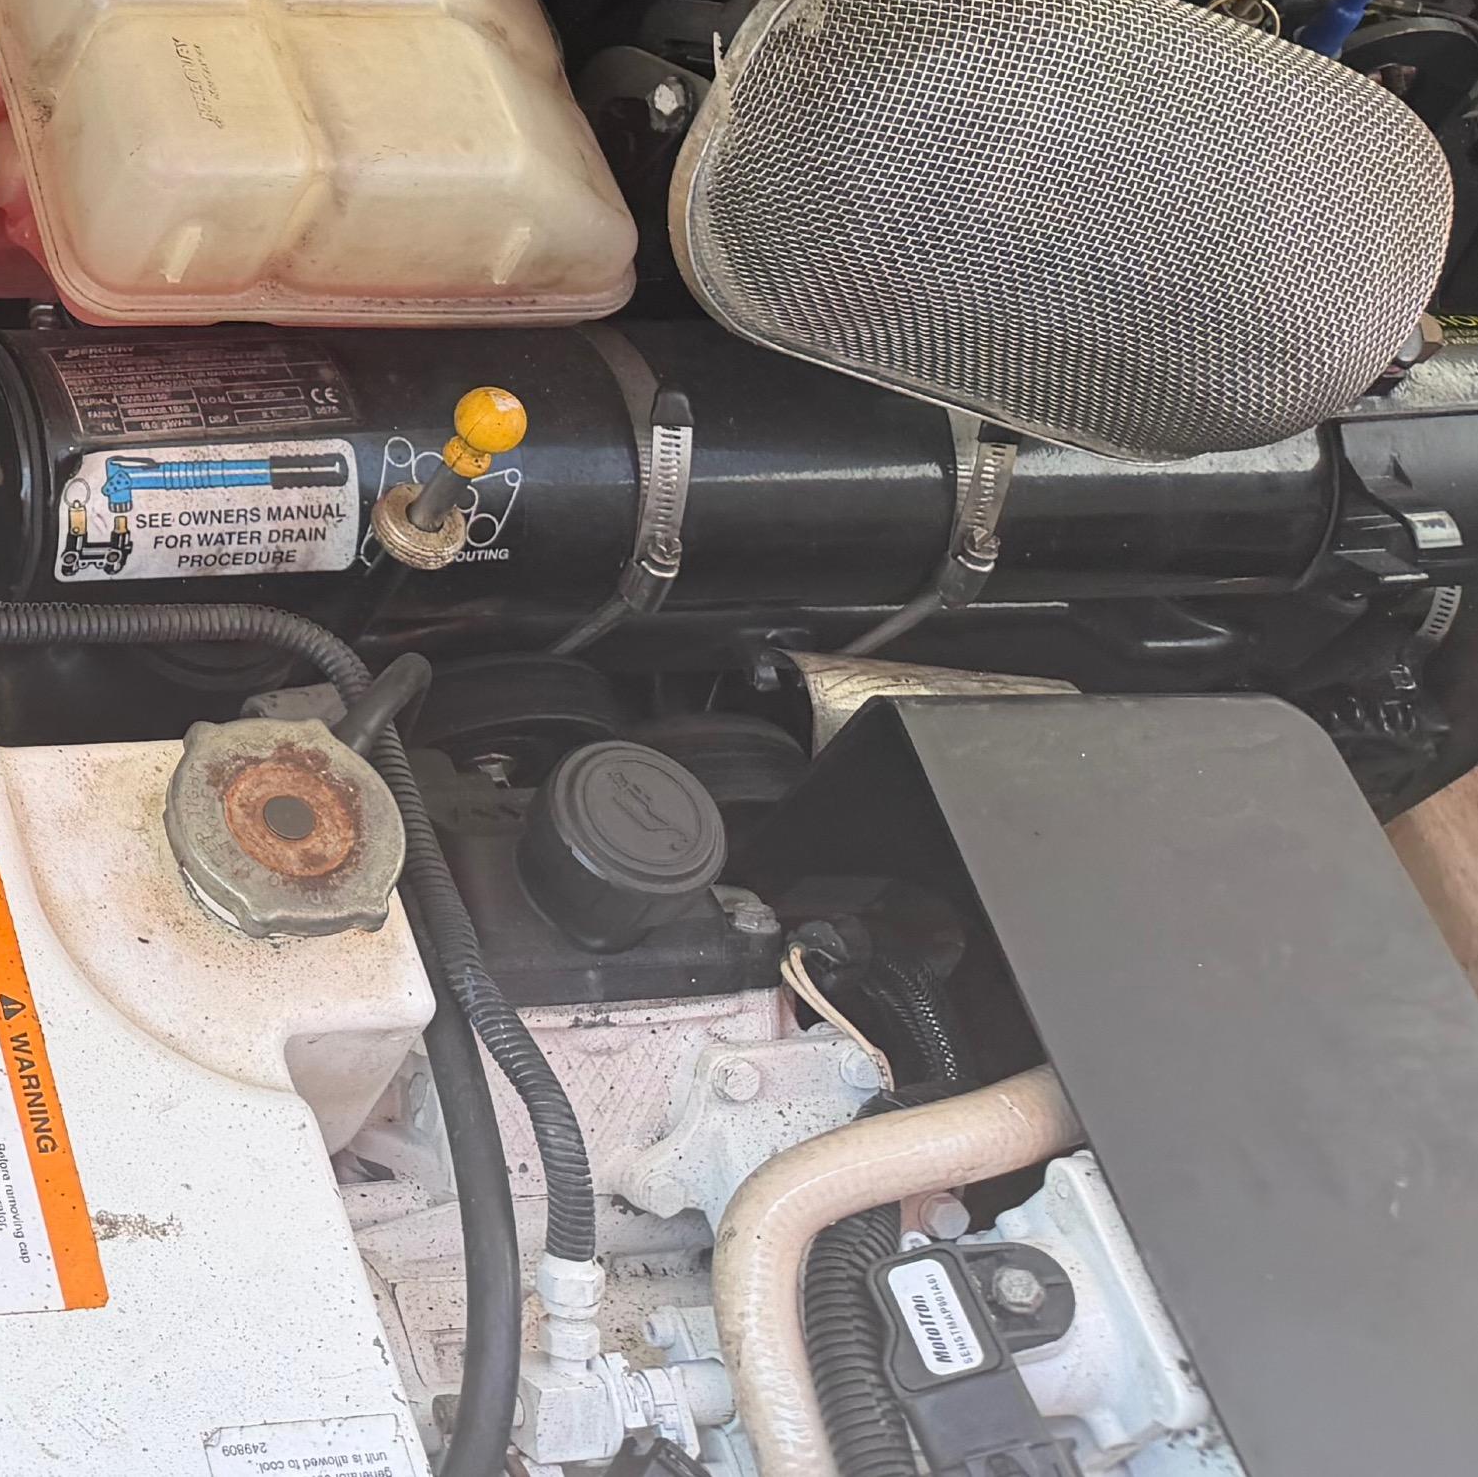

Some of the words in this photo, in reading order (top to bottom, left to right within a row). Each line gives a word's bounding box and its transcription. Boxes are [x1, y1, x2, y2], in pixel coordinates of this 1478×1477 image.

[136, 513, 173, 528] SEE
[179, 508, 260, 526] OWNERS
[267, 504, 346, 522] MANUAL
[154, 535, 191, 549] FOR
[197, 531, 261, 547] WATER
[268, 528, 327, 544] DRAIN
[177, 550, 297, 568] PROCEDURE
[9, 1032, 57, 1154] WARNING
[912, 1295, 953, 1362] MotoTron
[222, 1442, 267, 1456] 249809
